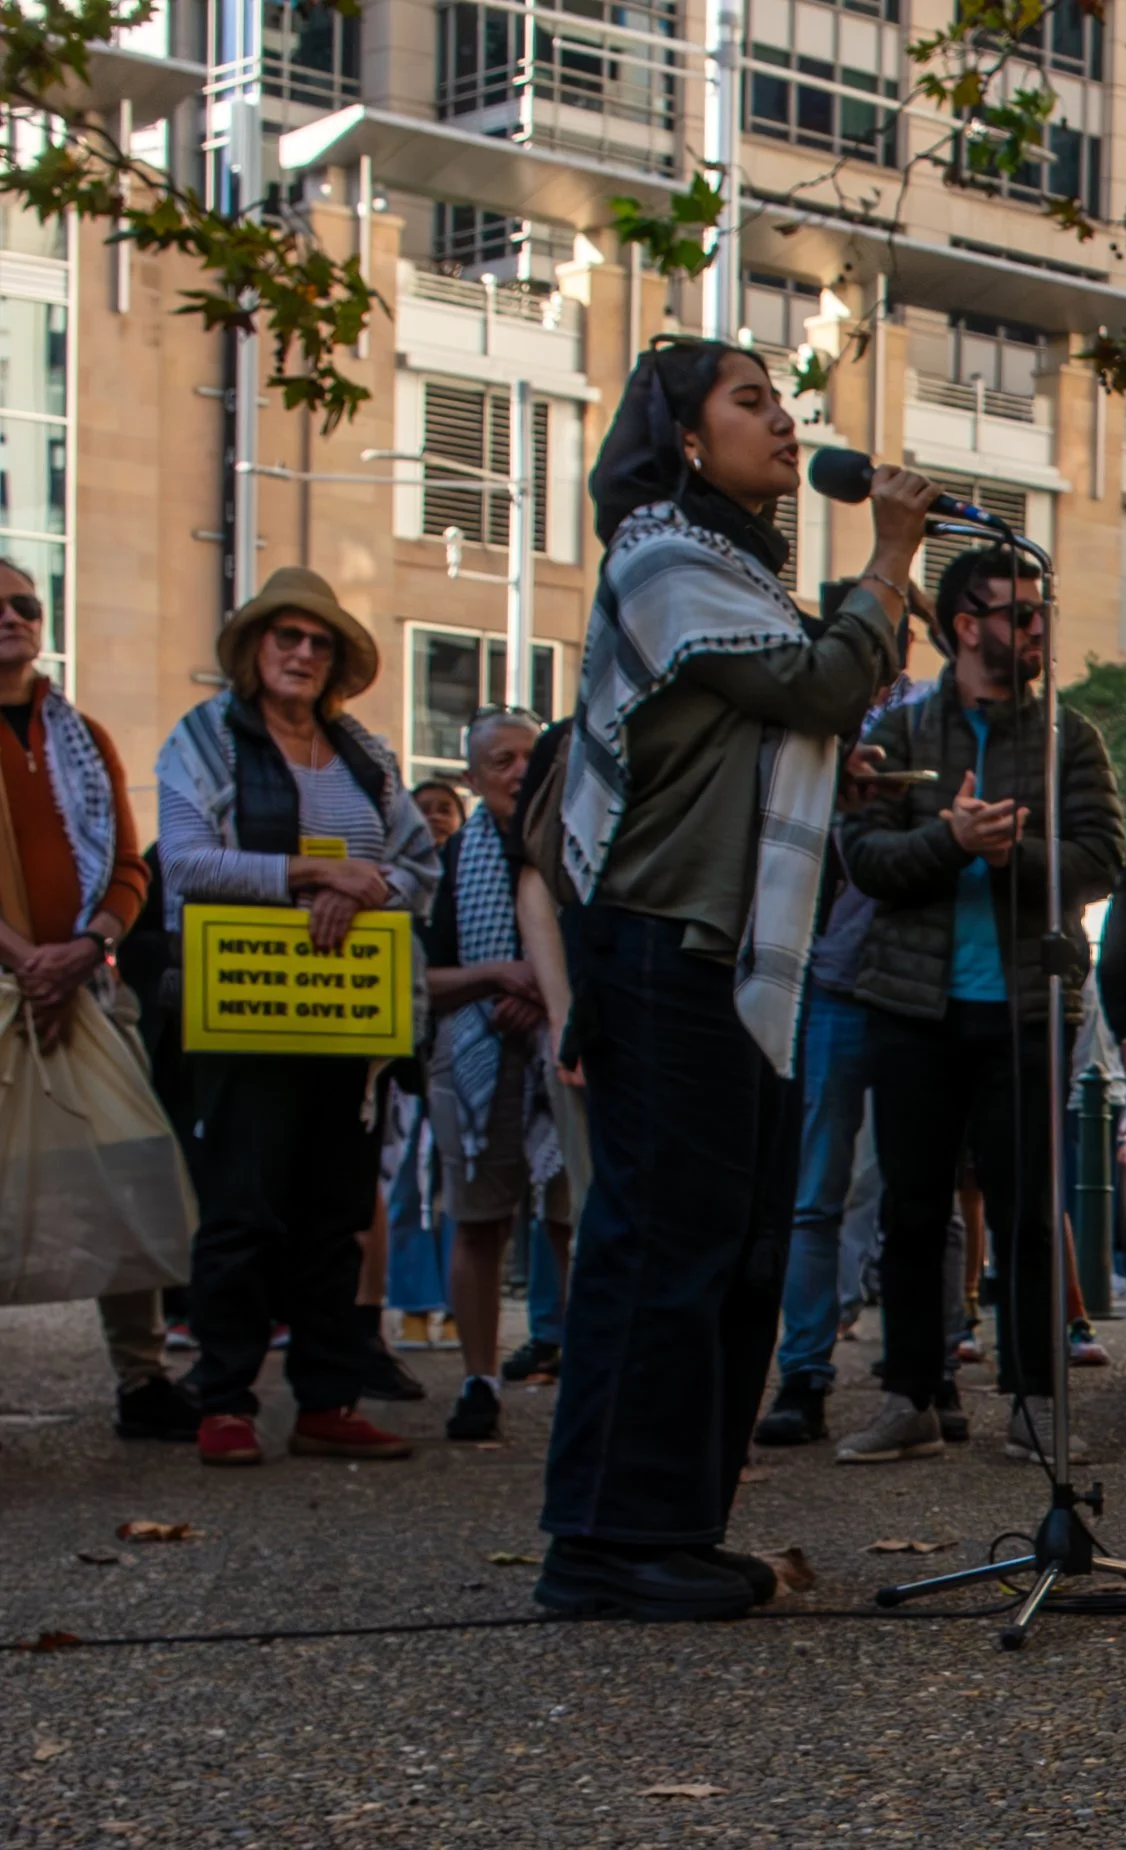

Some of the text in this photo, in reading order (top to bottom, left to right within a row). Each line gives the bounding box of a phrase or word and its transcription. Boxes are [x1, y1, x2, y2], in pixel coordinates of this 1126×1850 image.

[218, 940, 287, 955] NEVER
[351, 944, 380, 958] UP
[218, 969, 380, 989] NEVER GIVE UP
[218, 1000, 380, 1019] NEVER GIVE UP
